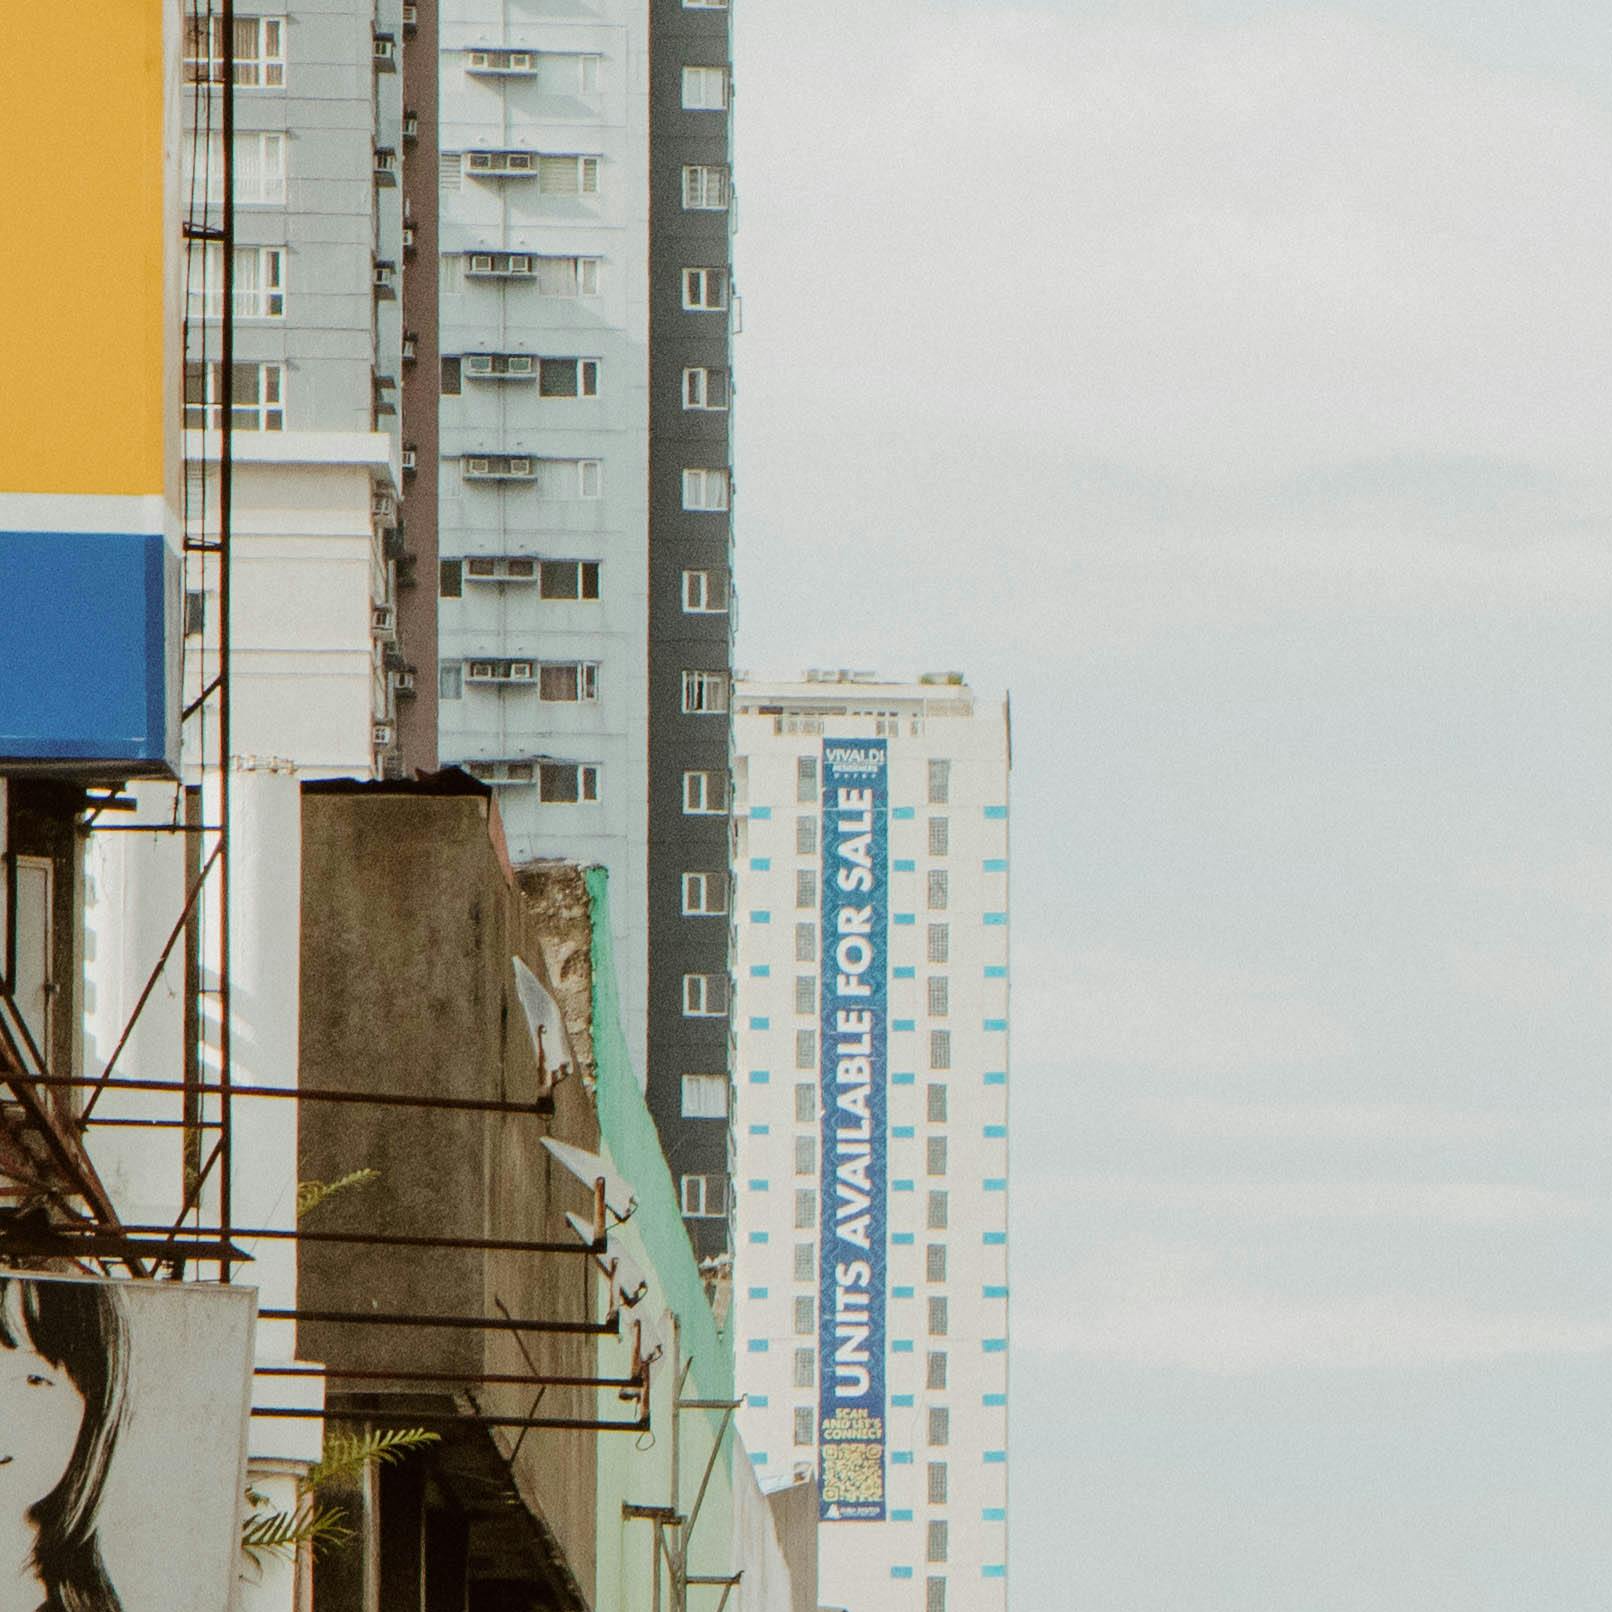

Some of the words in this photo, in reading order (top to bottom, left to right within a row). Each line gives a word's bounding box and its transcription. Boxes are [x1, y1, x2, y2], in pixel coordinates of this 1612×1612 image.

[826, 748, 884, 761] VIVALDI
[836, 787, 873, 893] SALE
[836, 905, 873, 997] FOR
[835, 1009, 872, 1250] AVAILABLE
[834, 1259, 871, 1399] UNITS
[823, 1429, 882, 1440] CONNECT
